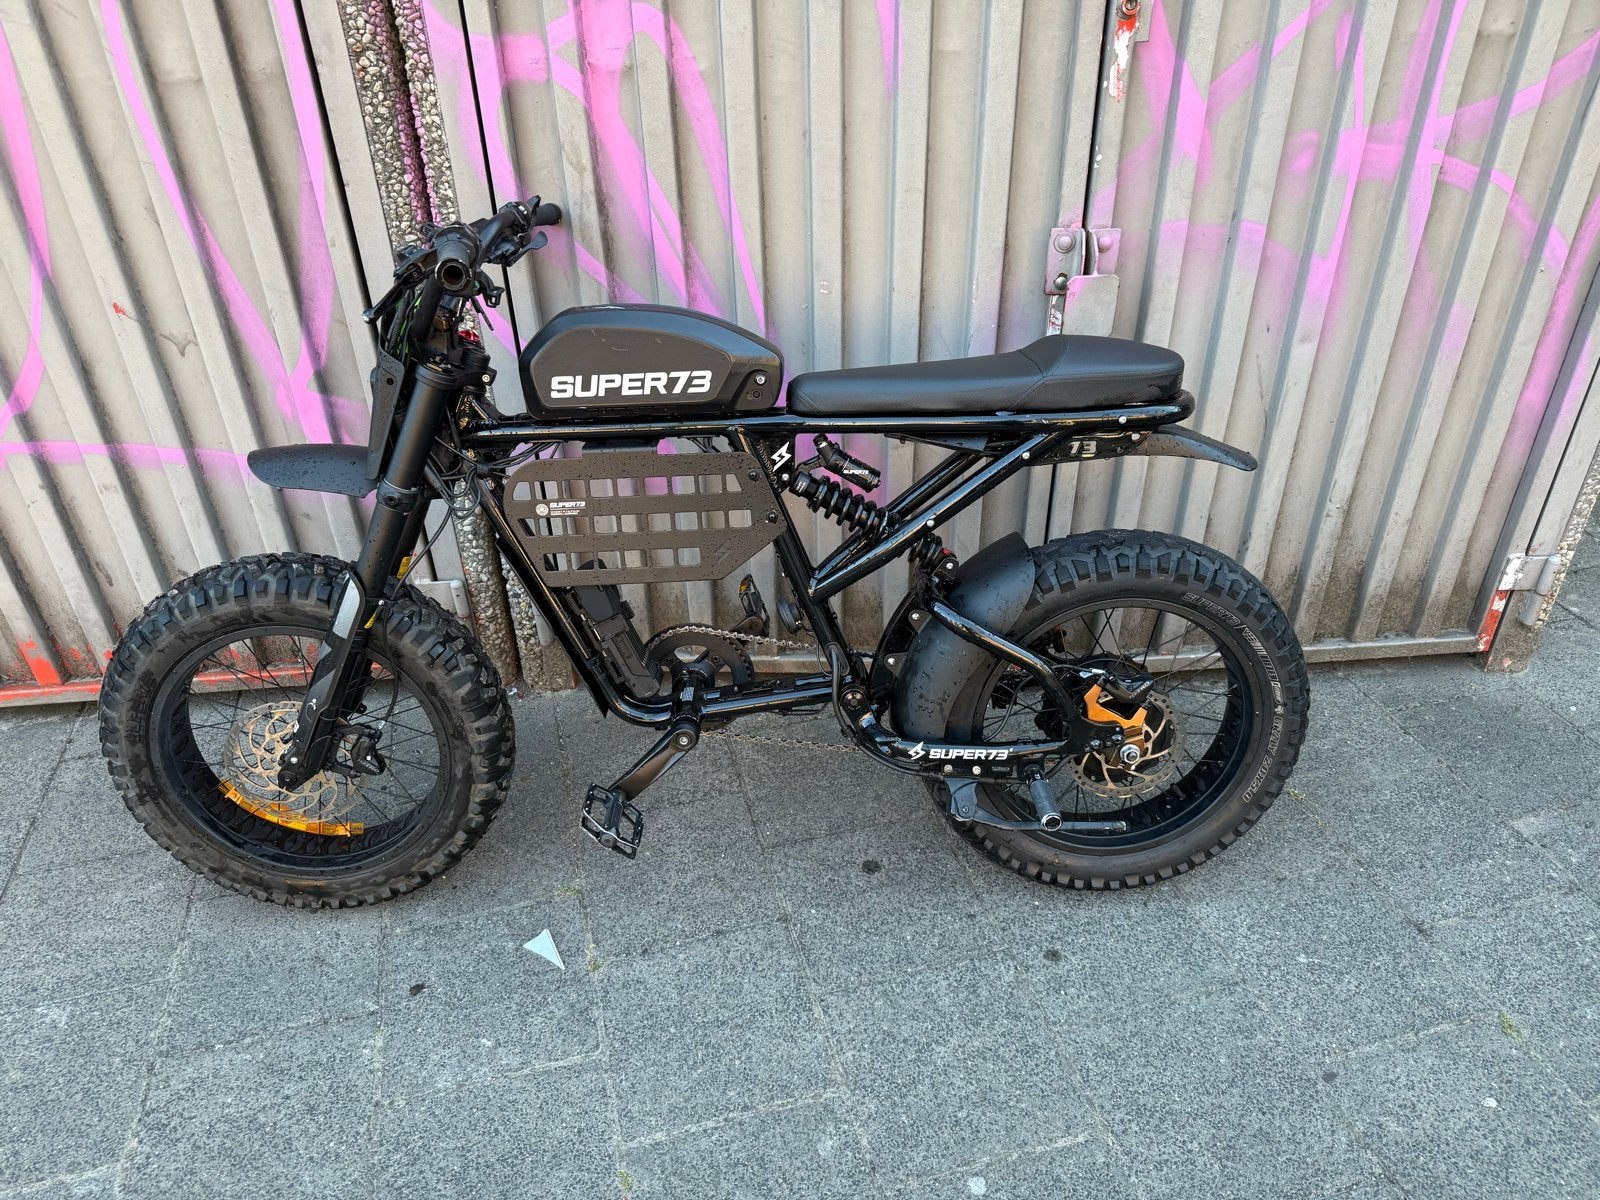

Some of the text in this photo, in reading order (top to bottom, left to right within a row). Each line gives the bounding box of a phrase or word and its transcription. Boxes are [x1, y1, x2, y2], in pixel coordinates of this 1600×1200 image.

[551, 370, 712, 399] SUPER73
[1184, 592, 1241, 626] SUPER73
[929, 748, 1009, 760] SUPER73
